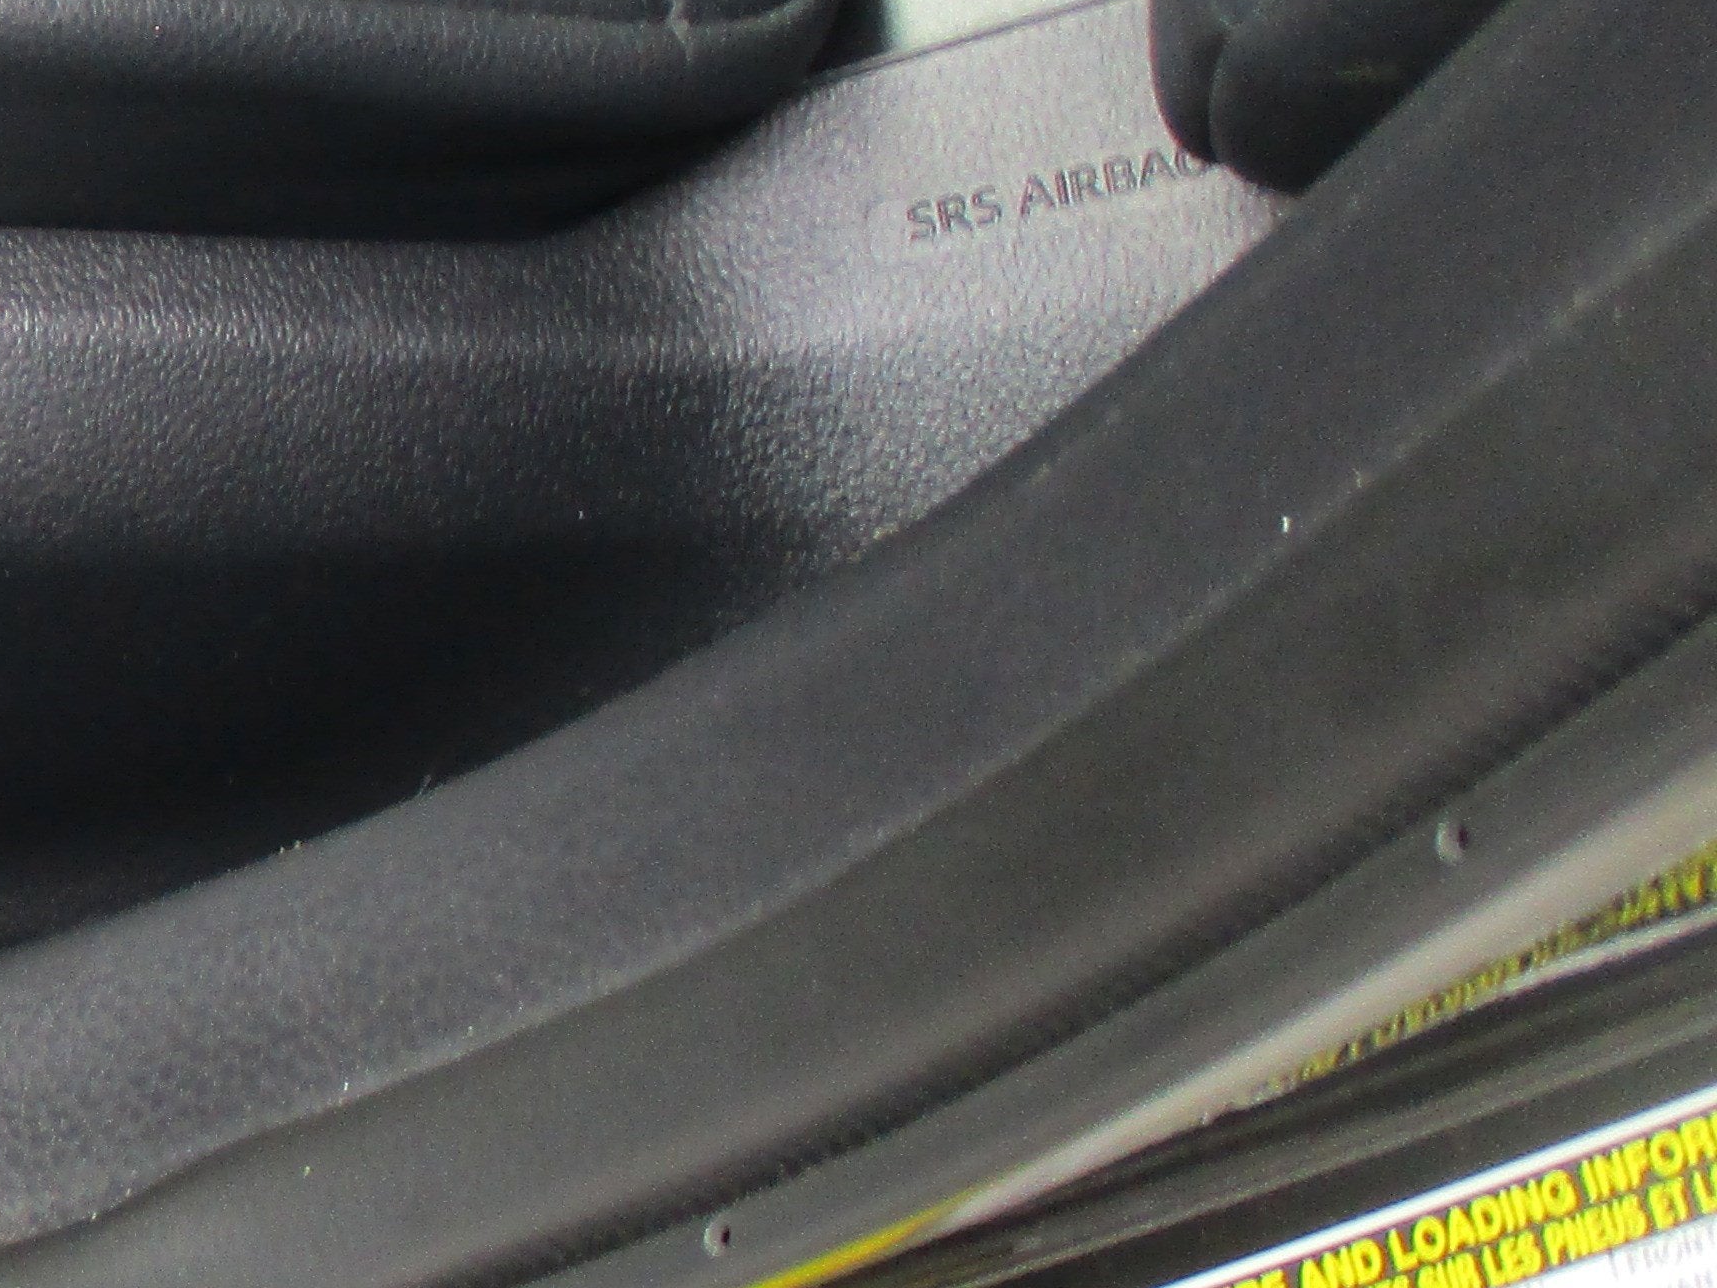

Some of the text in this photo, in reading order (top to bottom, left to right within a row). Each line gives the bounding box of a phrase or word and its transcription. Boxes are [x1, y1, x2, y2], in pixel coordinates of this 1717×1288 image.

[905, 183, 1003, 243] SRS
[1387, 1168, 1579, 1273] LOADING
[1578, 1110, 1717, 1203] INFOR
[1481, 1230, 1543, 1288] LES
[1541, 1193, 1649, 1266] PNEUS
[1646, 1176, 1690, 1230] ET
